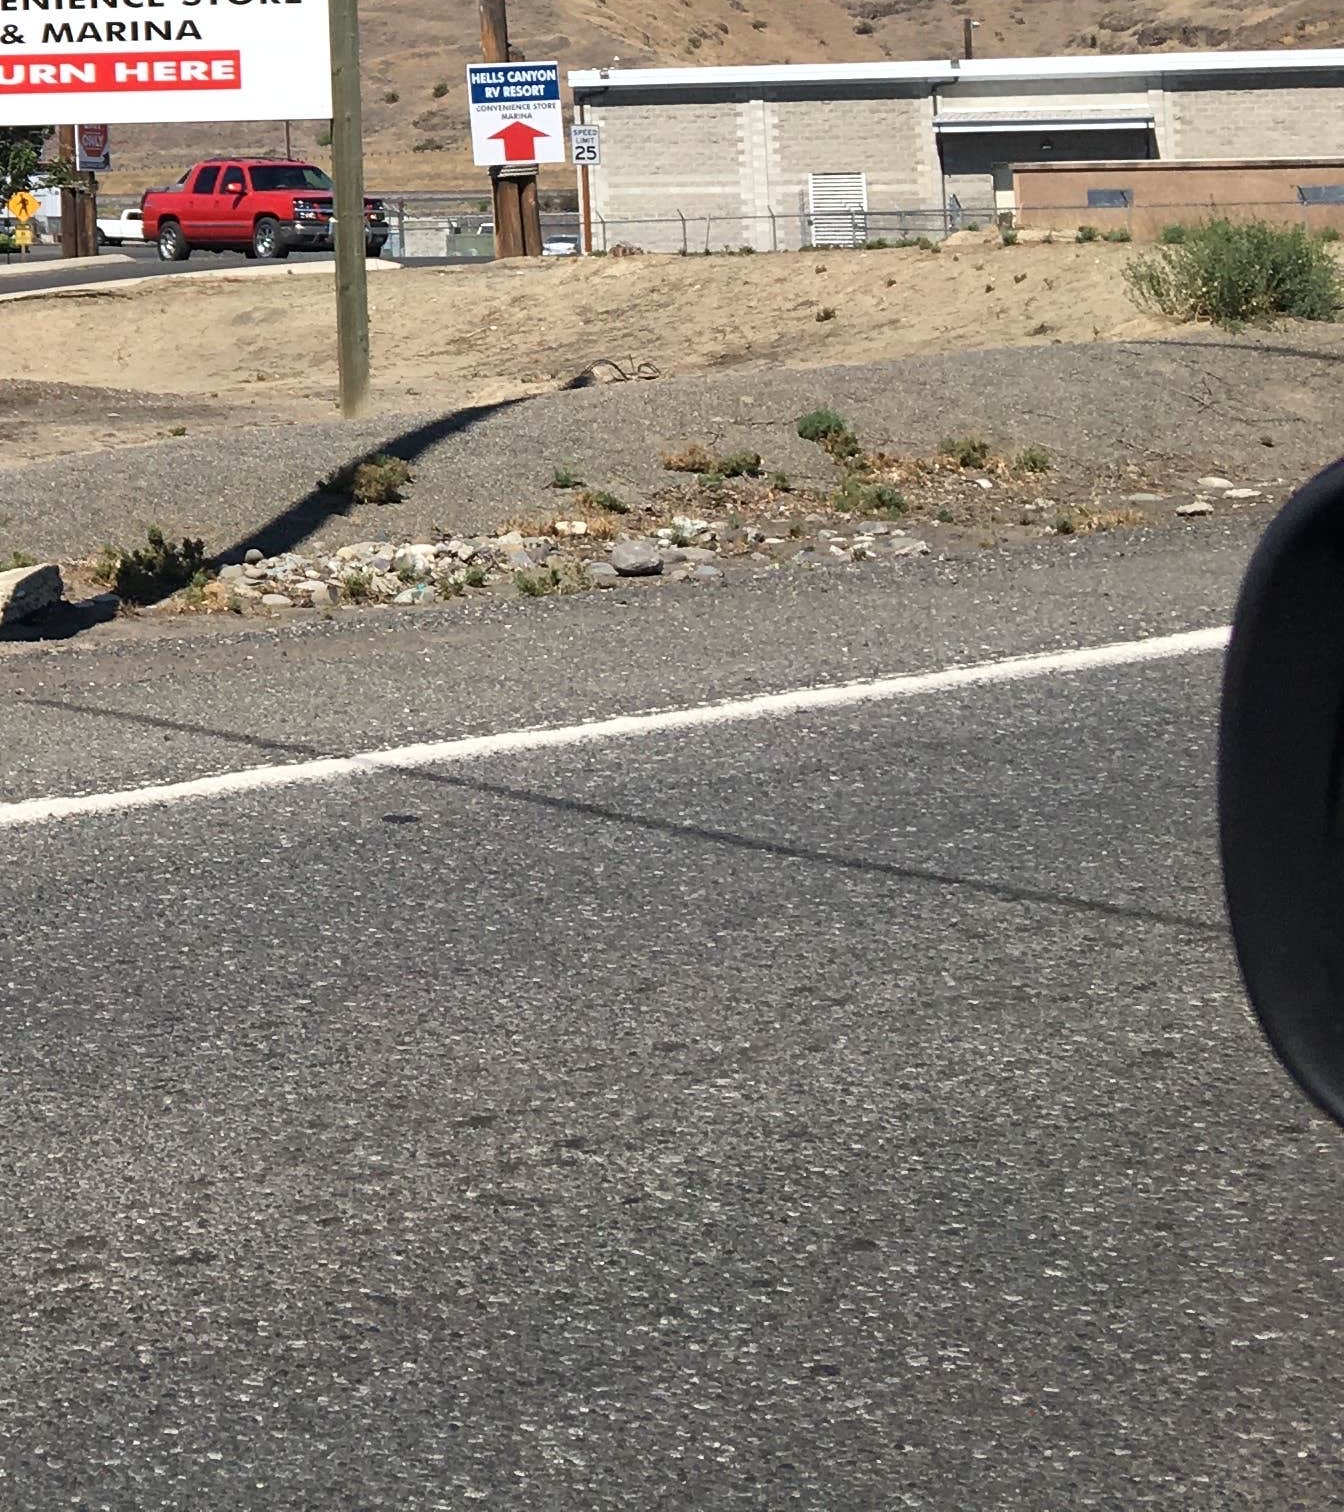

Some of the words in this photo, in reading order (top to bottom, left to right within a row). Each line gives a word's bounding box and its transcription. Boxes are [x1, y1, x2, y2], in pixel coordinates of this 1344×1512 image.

[0, 24, 26, 45] &
[41, 20, 203, 44] MARINA
[114, 59, 236, 83] HERE
[471, 71, 505, 84] HELLS
[507, 69, 557, 83] CANYON
[484, 86, 500, 98] RV
[502, 84, 546, 97] RESORT
[476, 104, 531, 112] CONVENIENCE
[533, 102, 557, 110] STORE
[574, 145, 597, 161] 25
